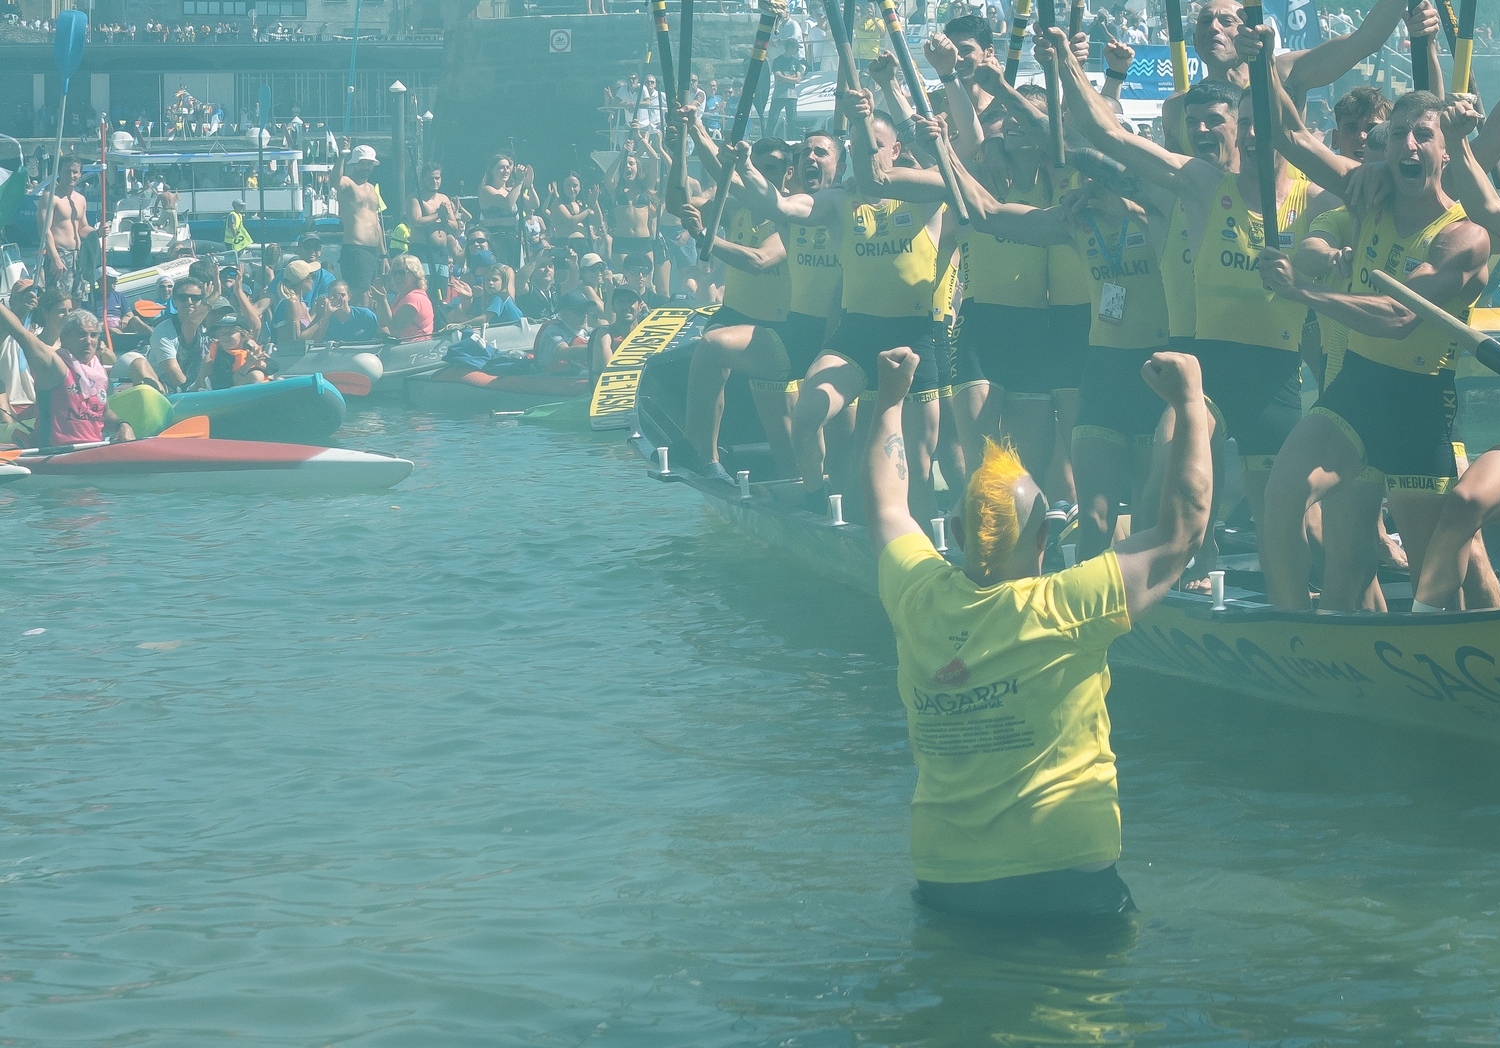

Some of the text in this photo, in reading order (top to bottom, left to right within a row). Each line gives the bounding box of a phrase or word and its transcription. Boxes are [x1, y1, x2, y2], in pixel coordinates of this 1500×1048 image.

[854, 238, 913, 257] ORIALKI
[1399, 477, 1435, 490] NEGUA
[913, 678, 1018, 712] SAGARDI
